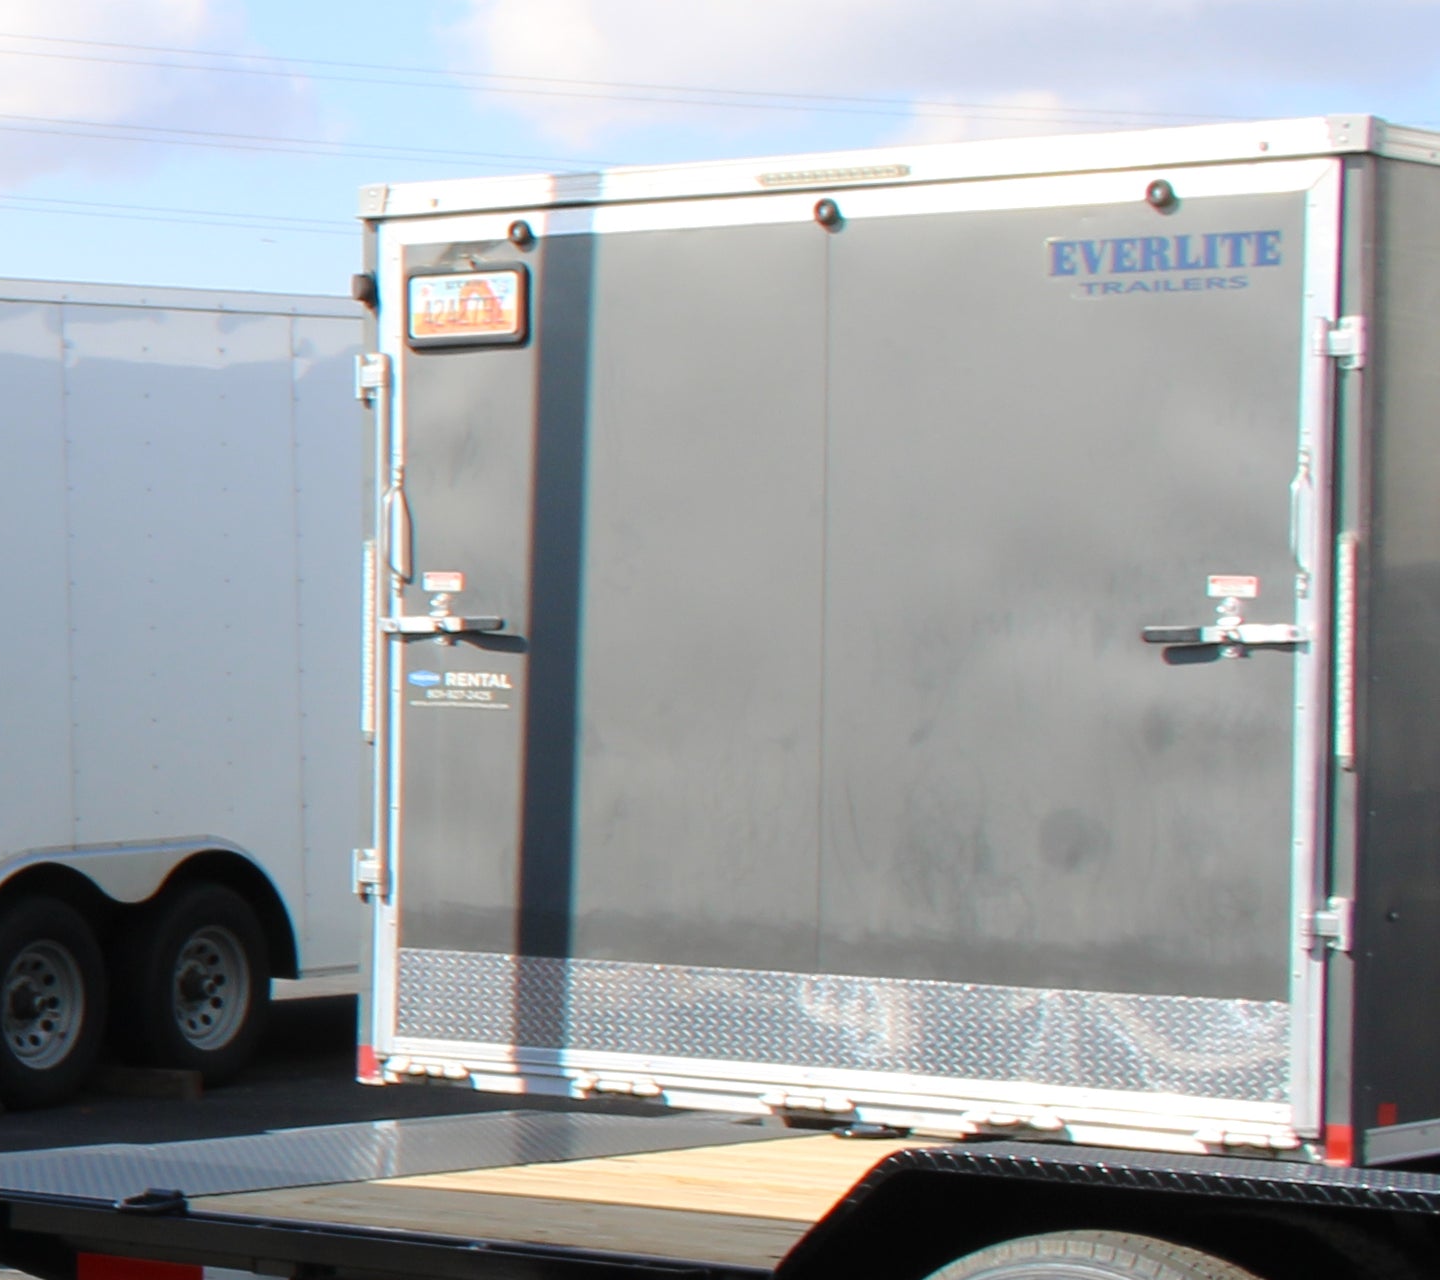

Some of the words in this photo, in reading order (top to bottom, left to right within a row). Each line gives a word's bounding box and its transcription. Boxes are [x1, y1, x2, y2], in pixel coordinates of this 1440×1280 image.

[1048, 230, 1281, 277] EVERLITE
[1079, 275, 1249, 295] TRAILERS
[444, 672, 512, 689] RENTAL
